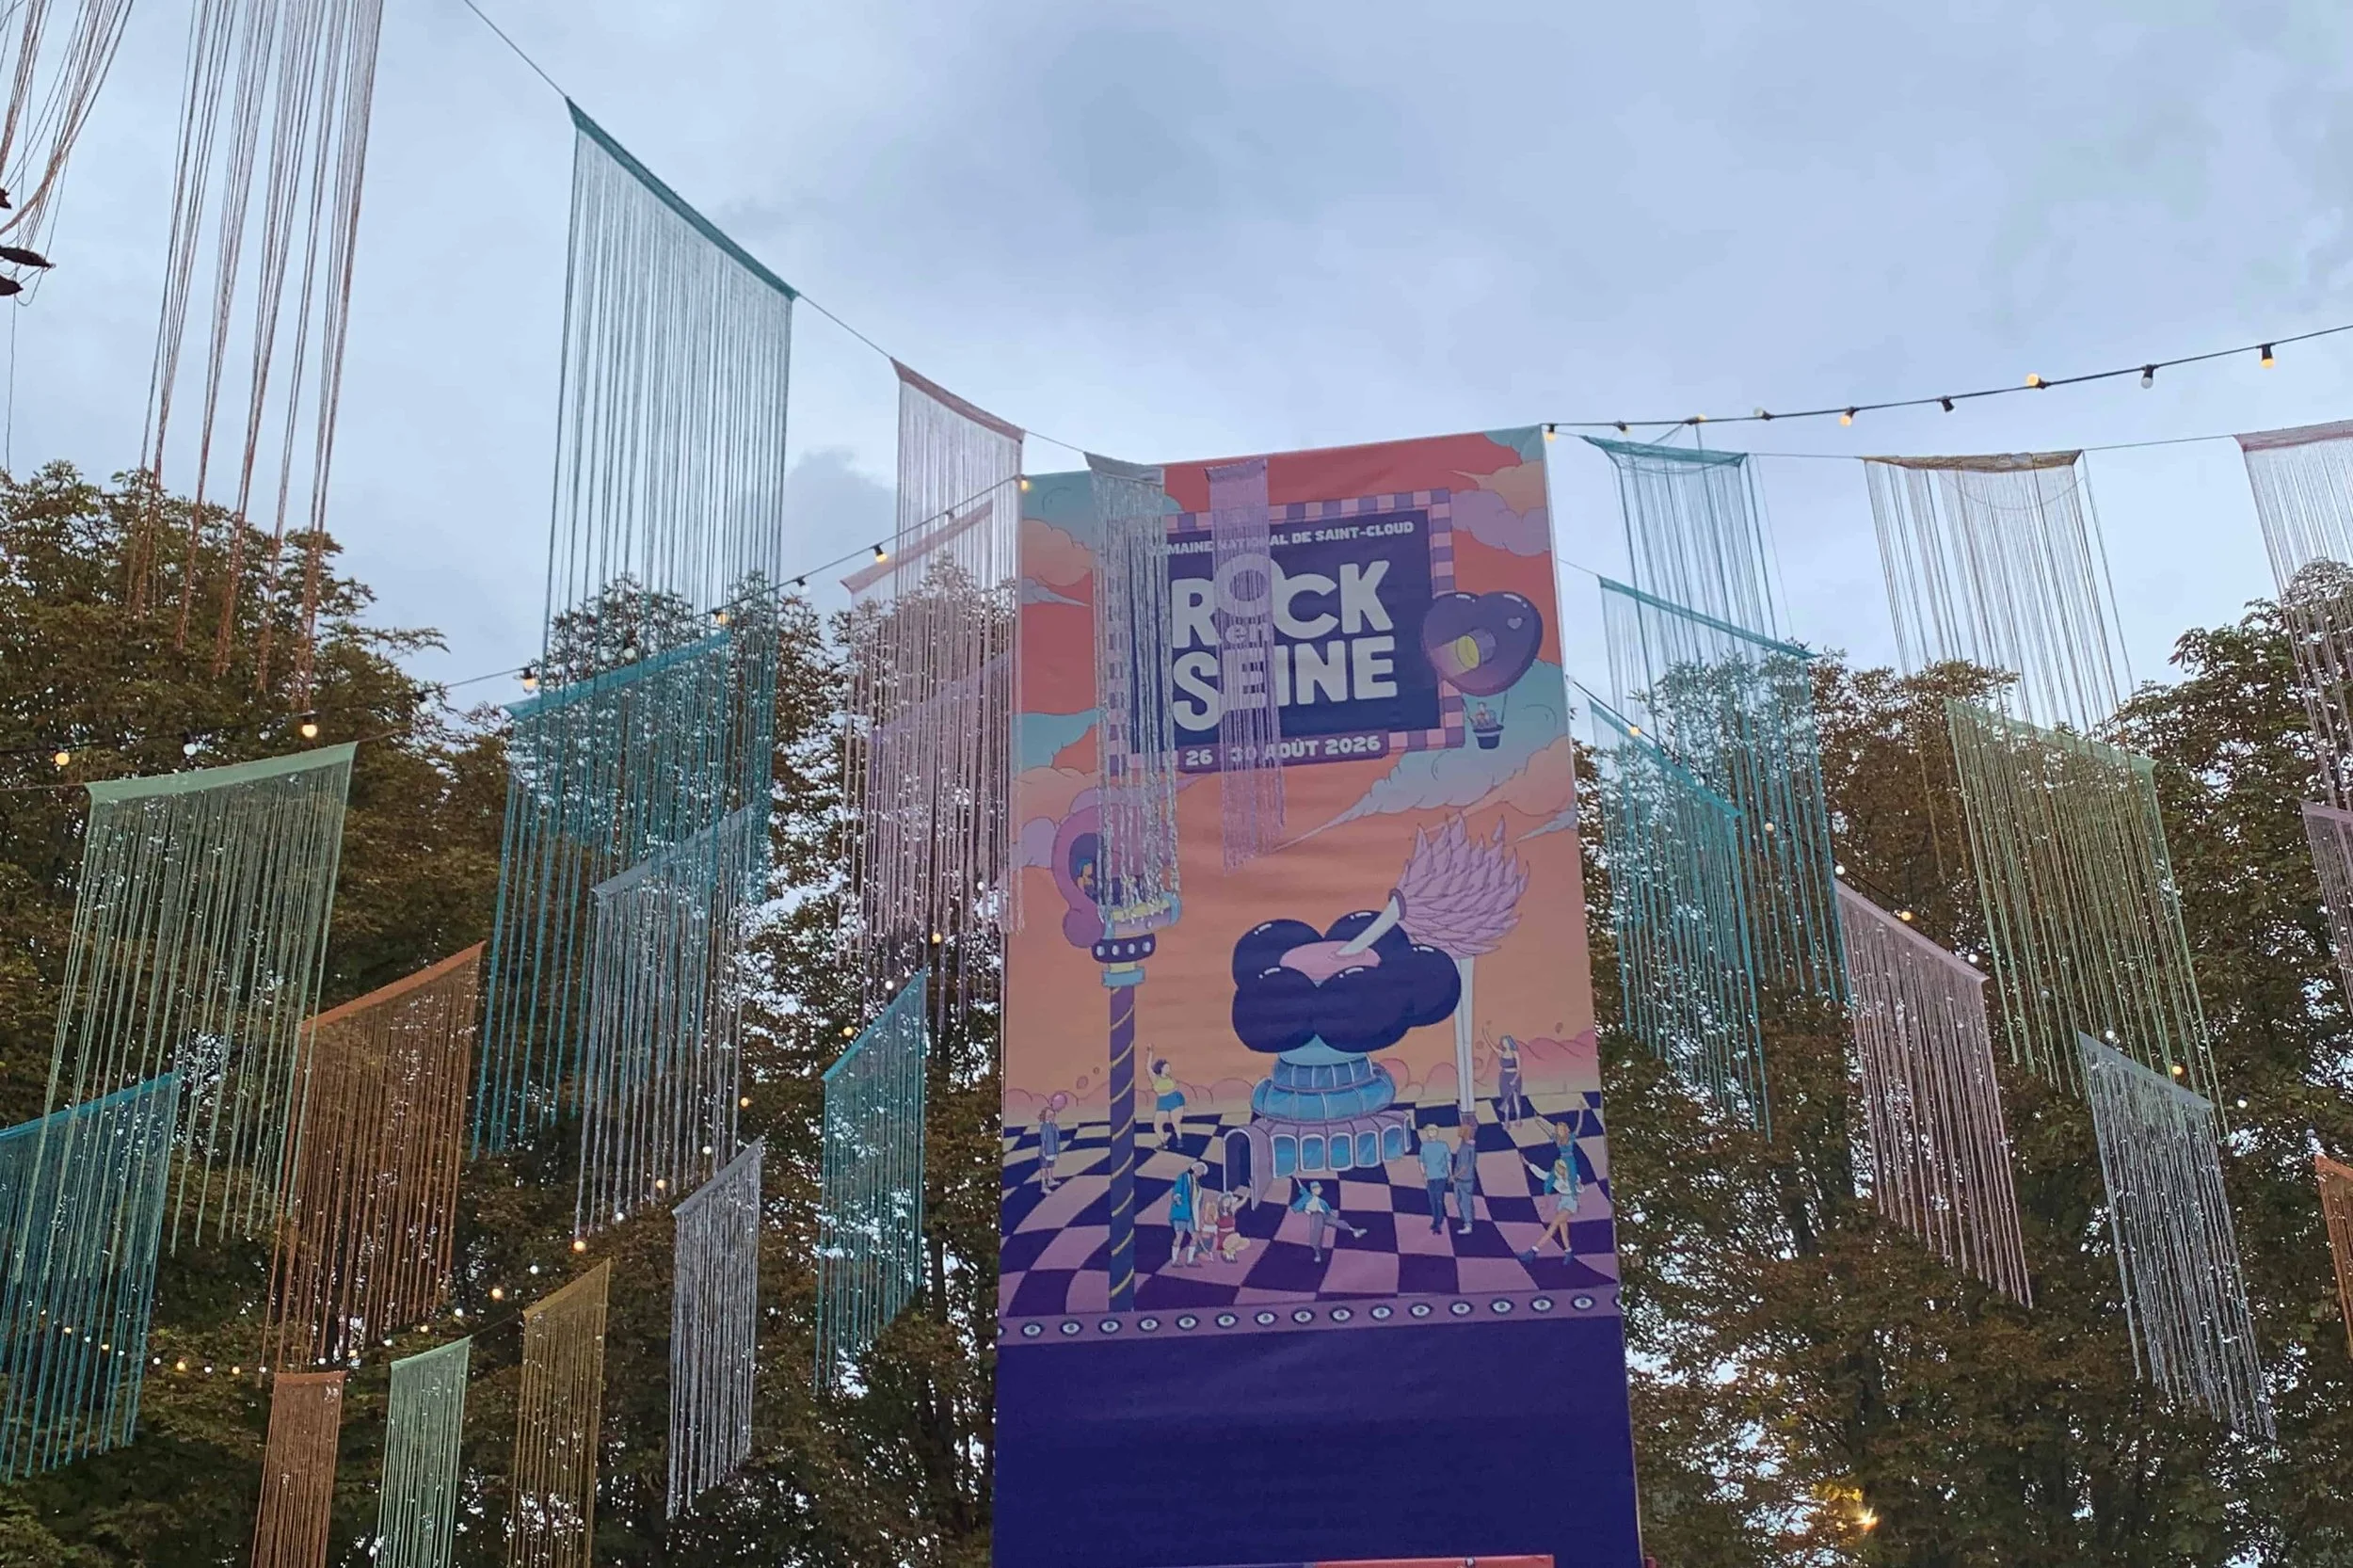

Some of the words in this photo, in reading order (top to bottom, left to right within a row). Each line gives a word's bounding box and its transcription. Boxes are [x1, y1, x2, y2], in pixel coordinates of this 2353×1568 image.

[1292, 531, 1312, 544] DE
[1315, 522, 1413, 540] SAINT-CLOUD
[1171, 553, 1393, 648] ROCK
[1225, 622, 1269, 643] en
[1173, 635, 1397, 730] SEINE
[1186, 749, 1212, 765] 26
[1264, 738, 1320, 760] AOÛT
[1324, 735, 1381, 755] 2026
